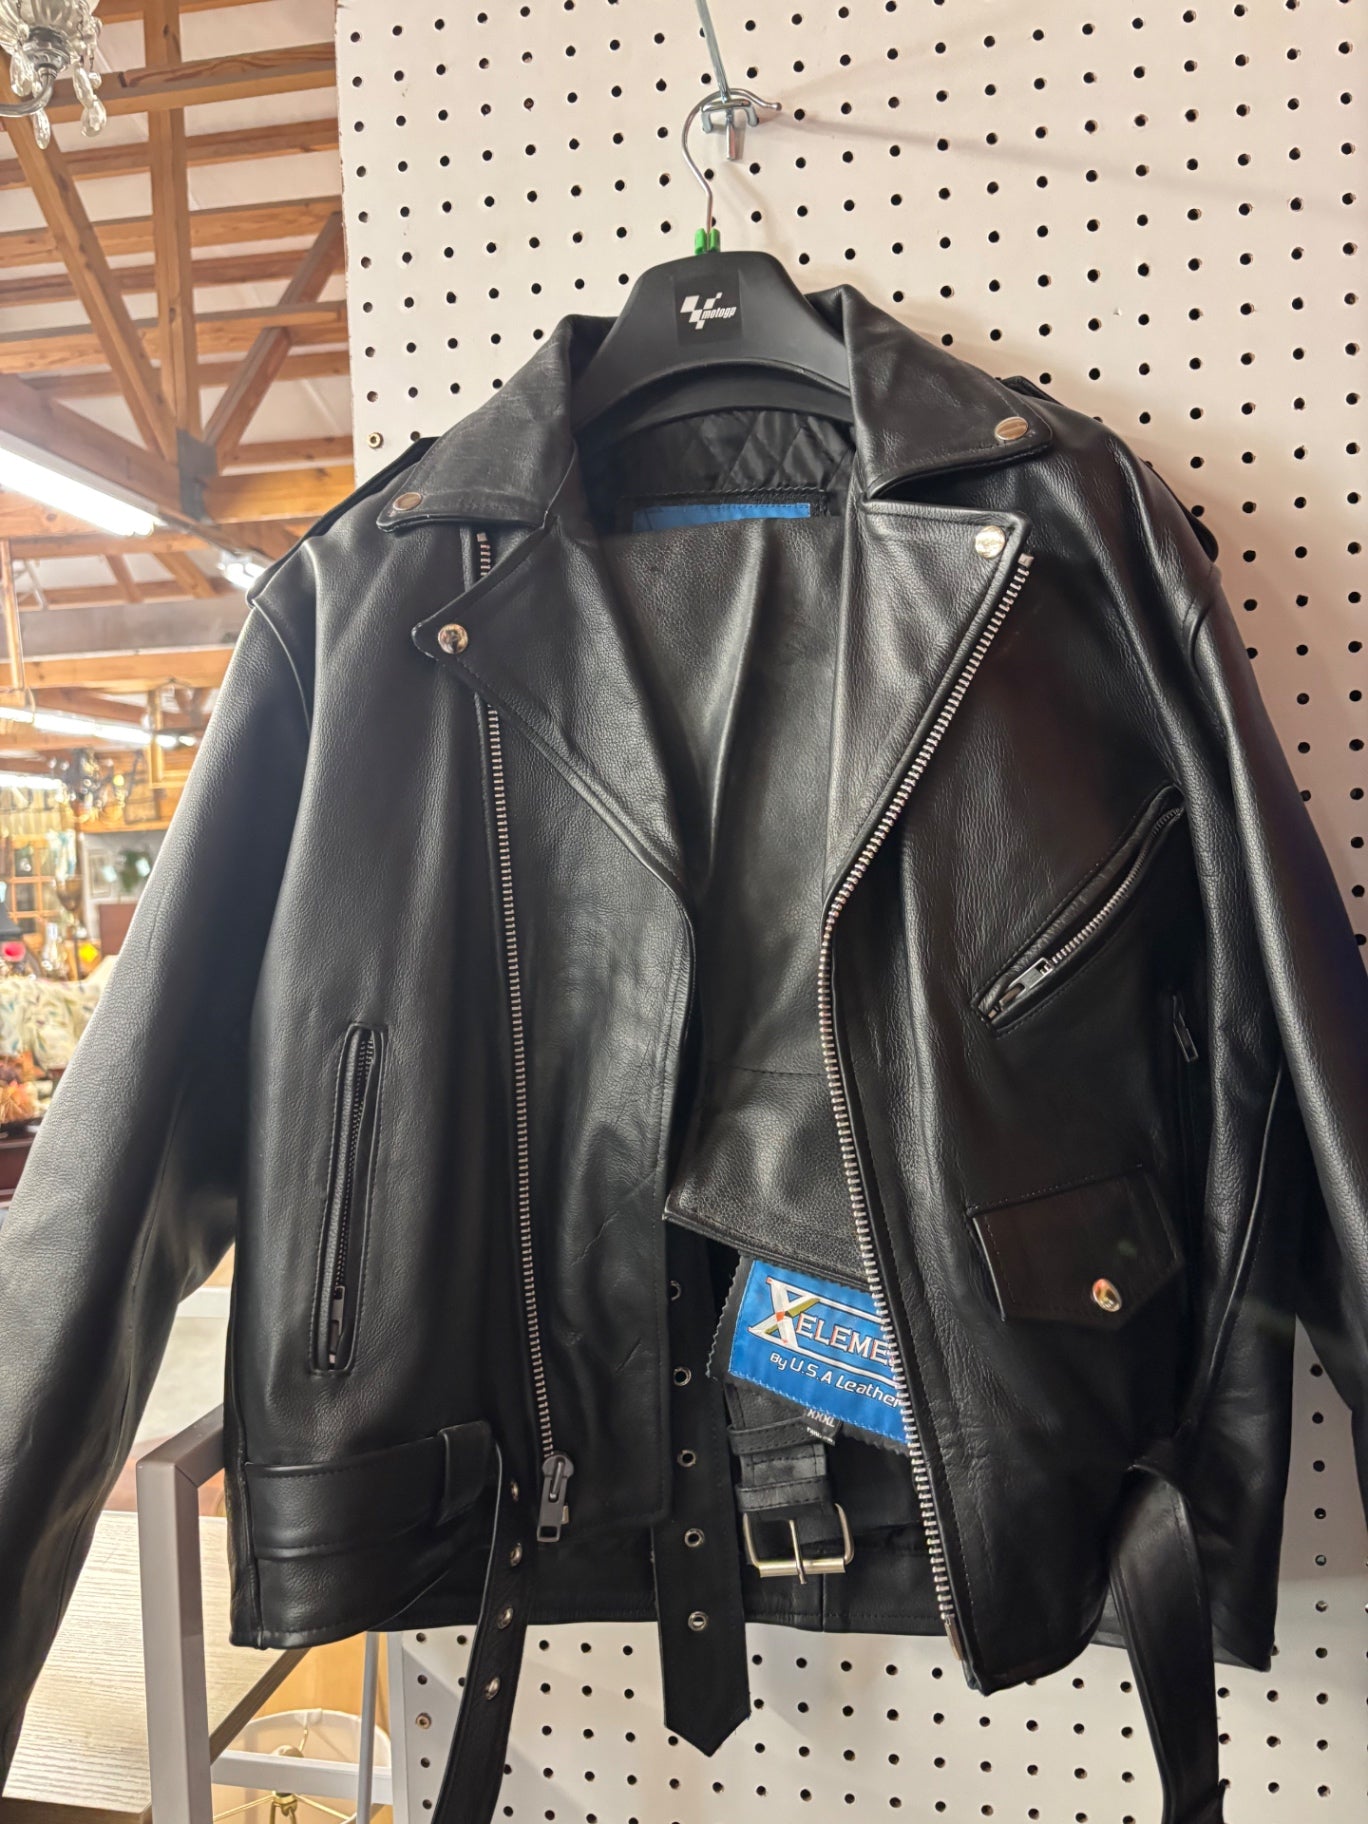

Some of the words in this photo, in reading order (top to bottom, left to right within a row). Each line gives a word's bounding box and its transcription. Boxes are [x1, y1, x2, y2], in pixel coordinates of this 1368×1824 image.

[747, 1276, 894, 1366] XELEME
[769, 1352, 787, 1371] By
[790, 1359, 832, 1383] U.S.A
